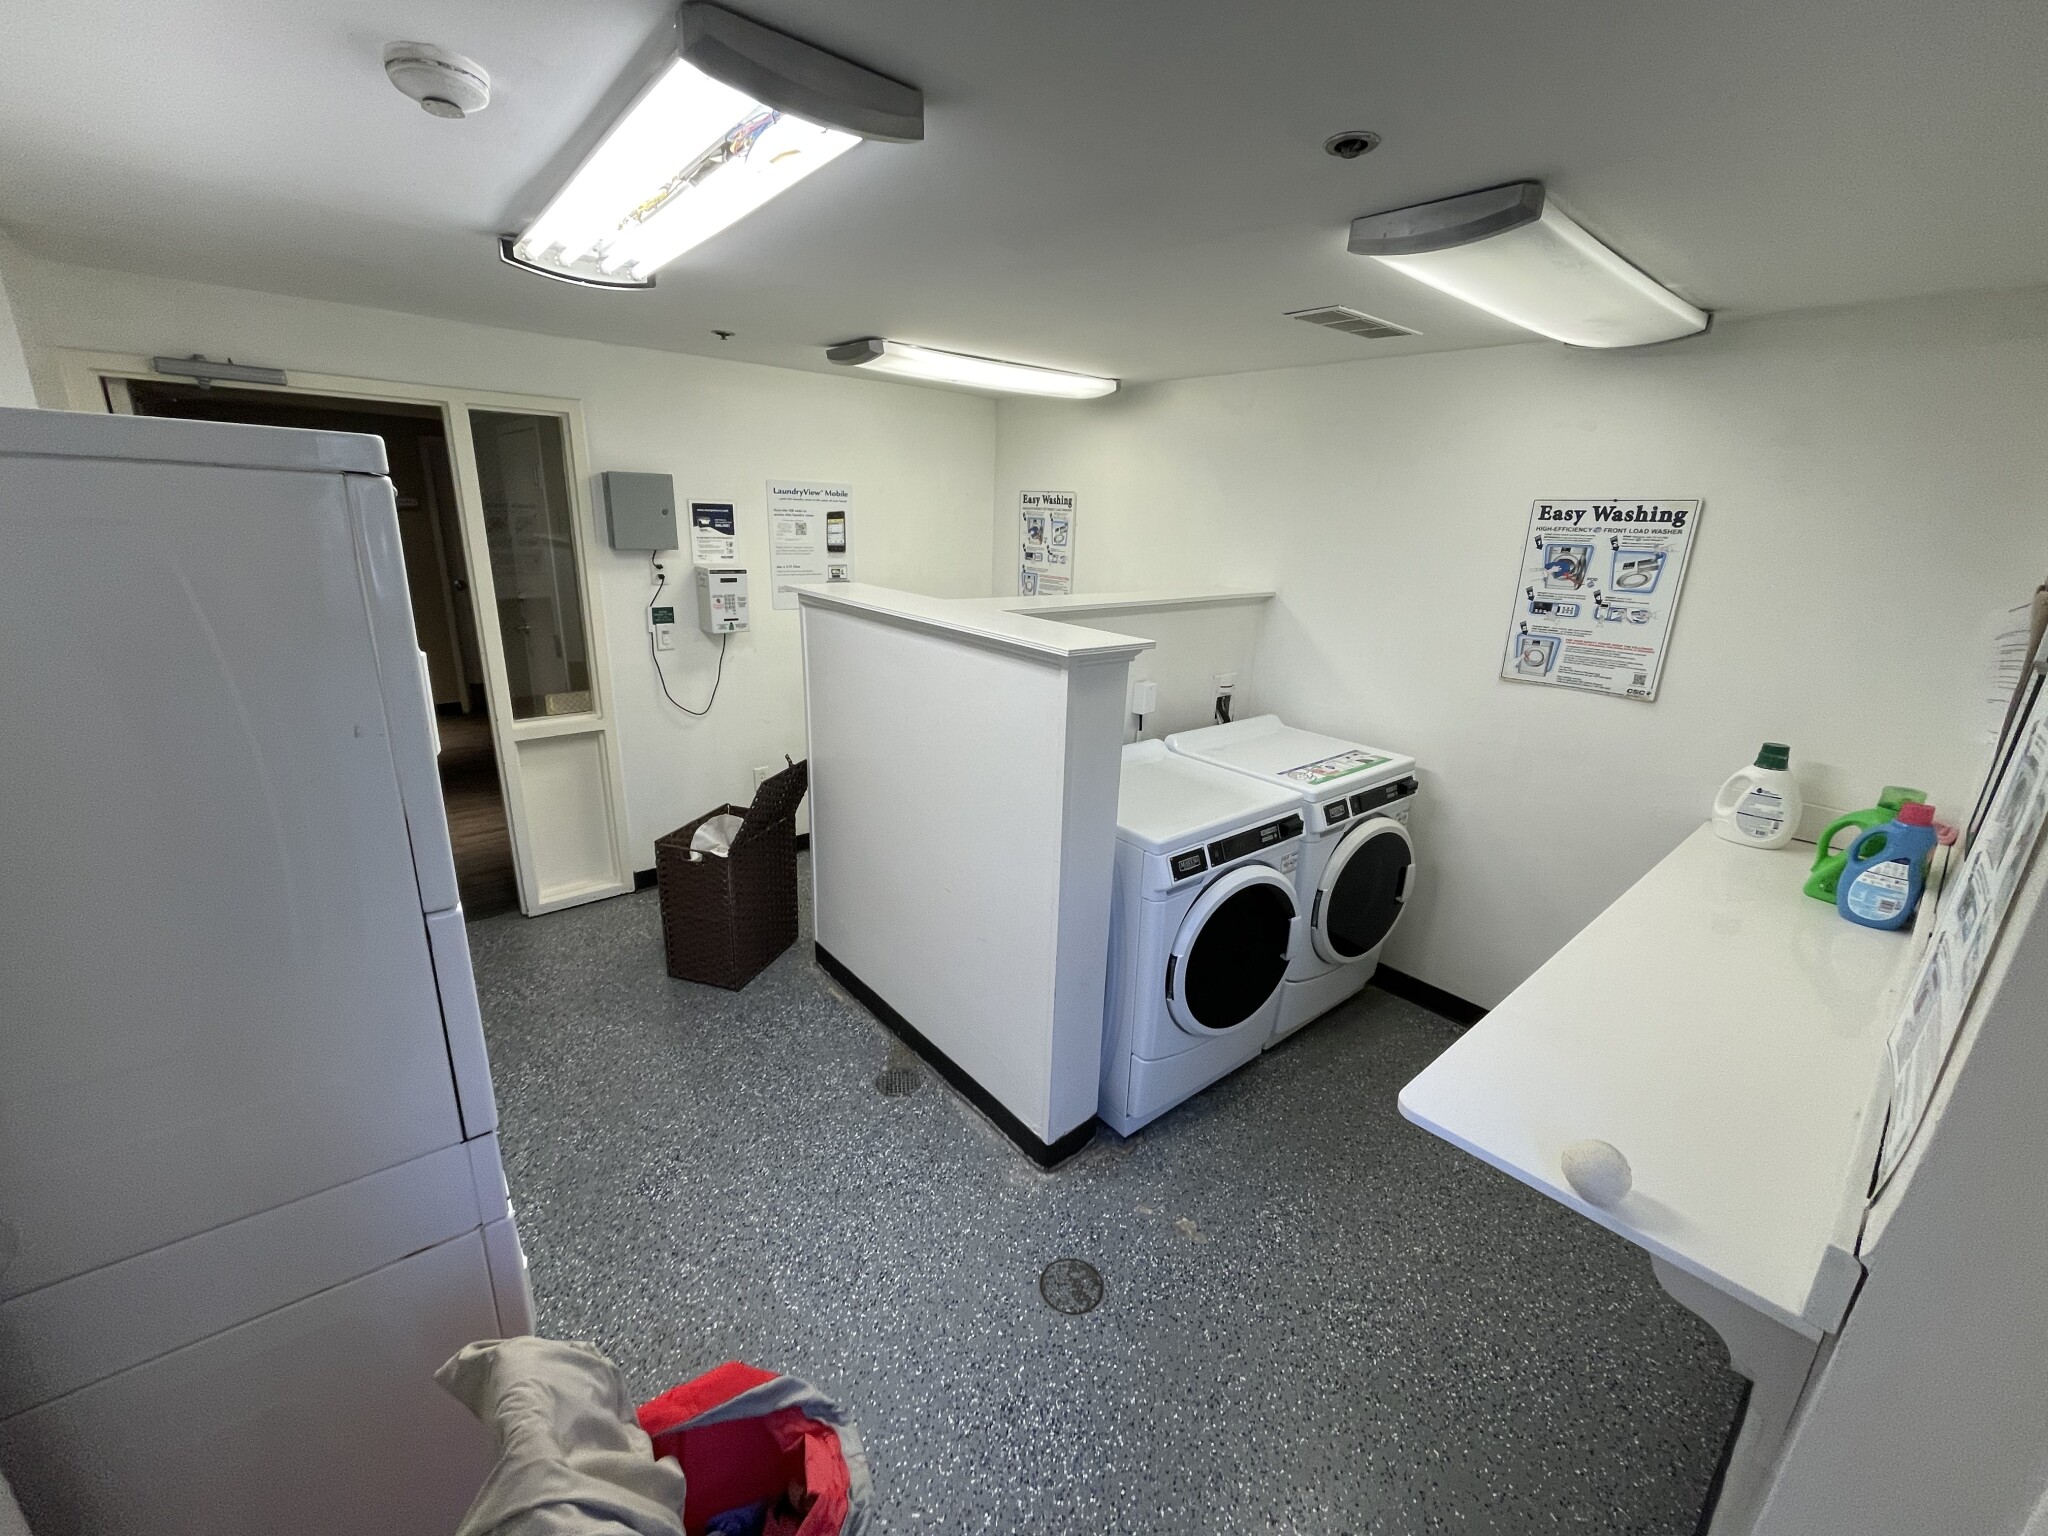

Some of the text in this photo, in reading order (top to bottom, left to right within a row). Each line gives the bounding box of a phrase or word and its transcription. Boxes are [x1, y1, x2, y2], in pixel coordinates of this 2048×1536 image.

[824, 489, 849, 498] Mobile
[1023, 494, 1072, 508] Easy Washing
[1537, 504, 1689, 528] Easy Washing
[1626, 688, 1646, 696] CSC
